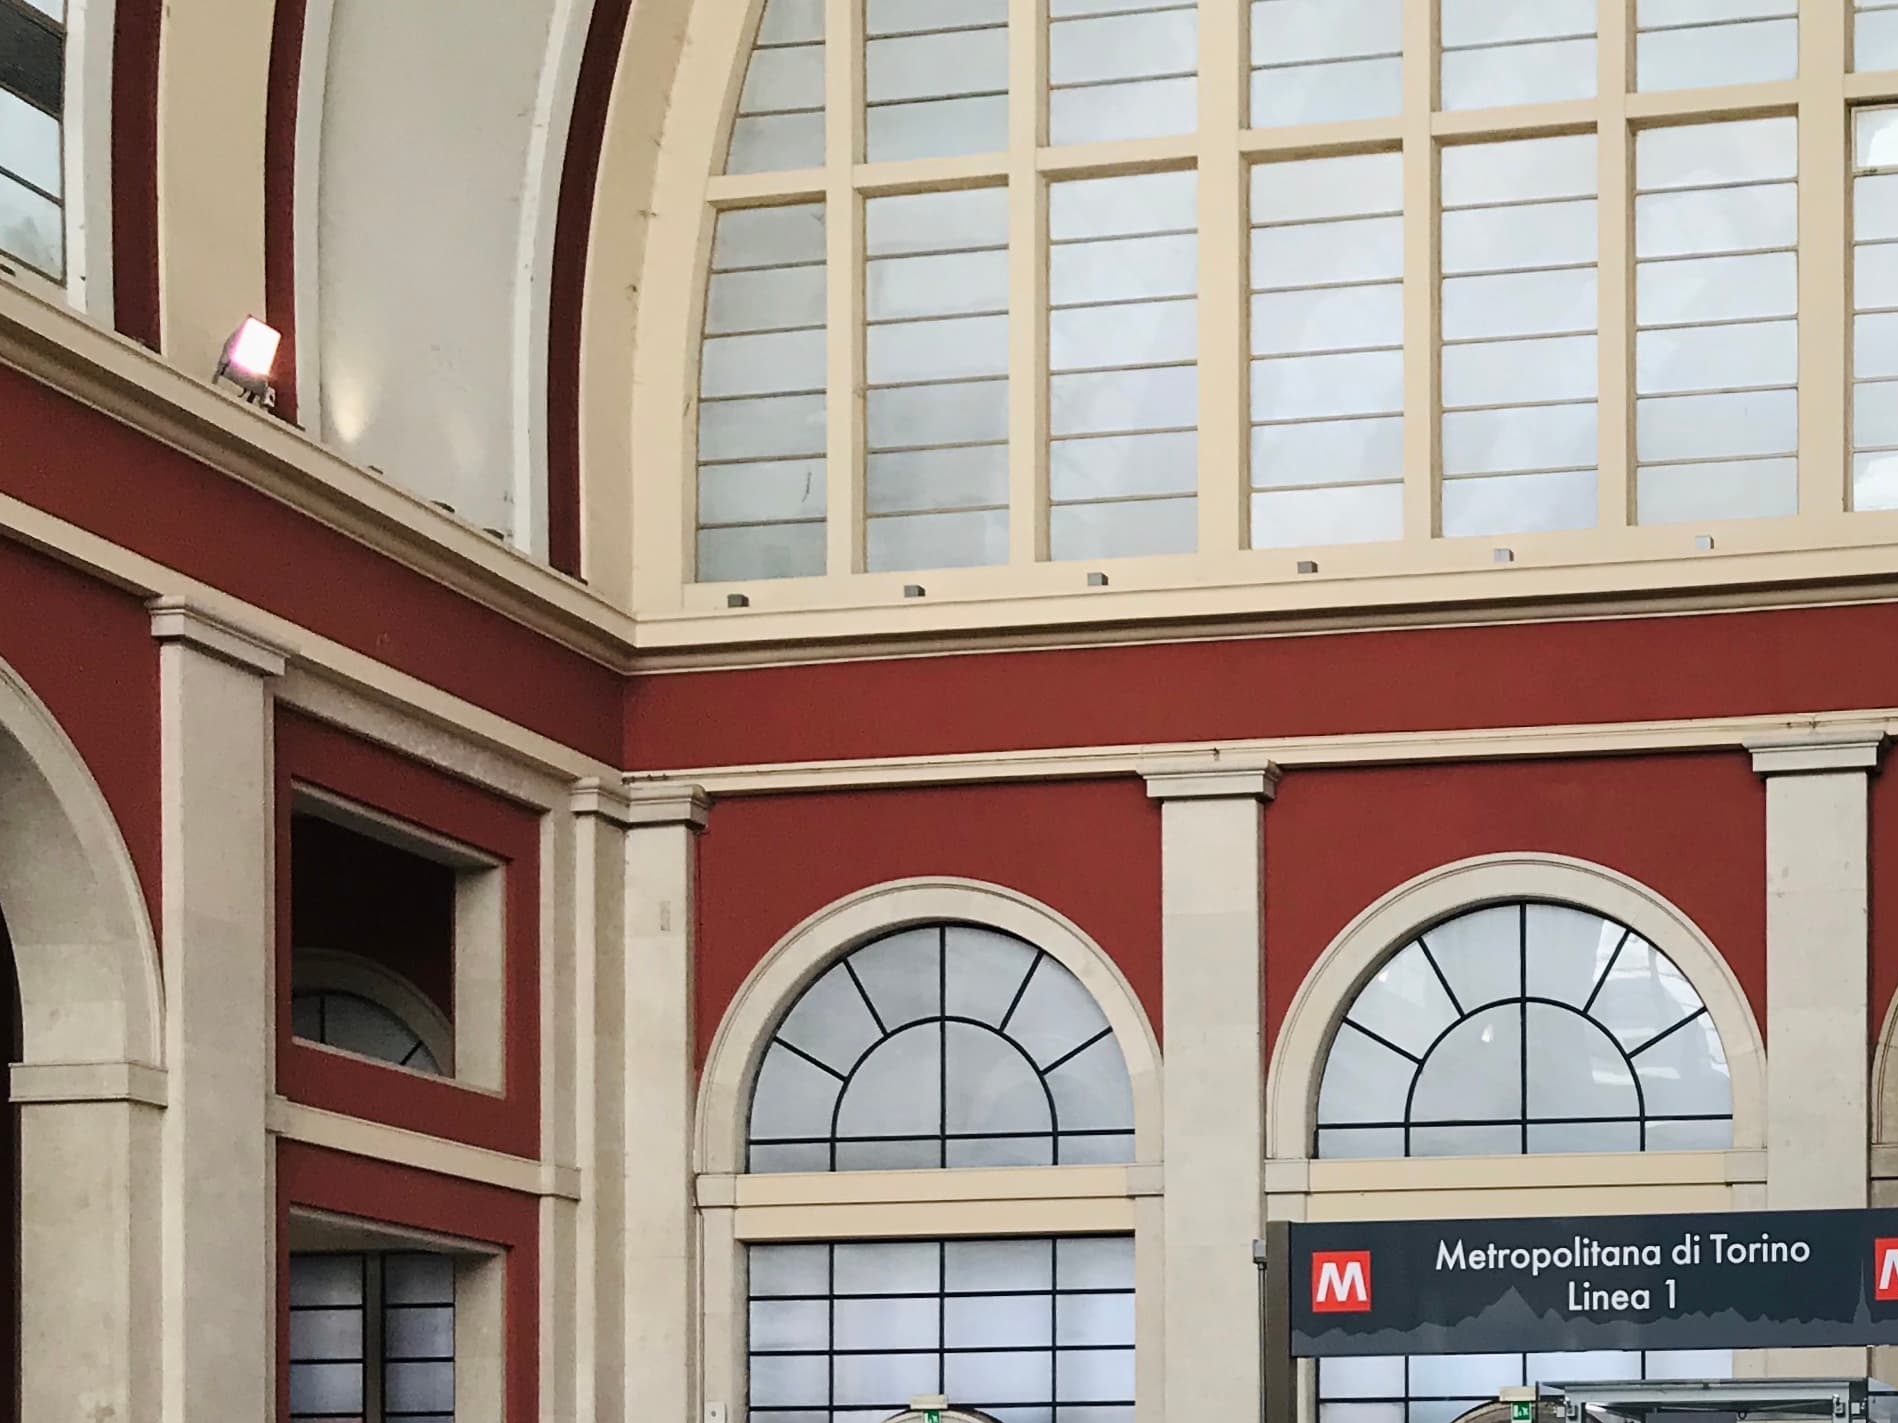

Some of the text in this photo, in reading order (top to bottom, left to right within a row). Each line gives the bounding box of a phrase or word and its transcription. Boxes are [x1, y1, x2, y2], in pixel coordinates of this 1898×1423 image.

[1436, 1233, 1810, 1276] Metropolitana di Torino
[1316, 1262, 1368, 1302] M
[1568, 1279, 1676, 1312] Linea 1
